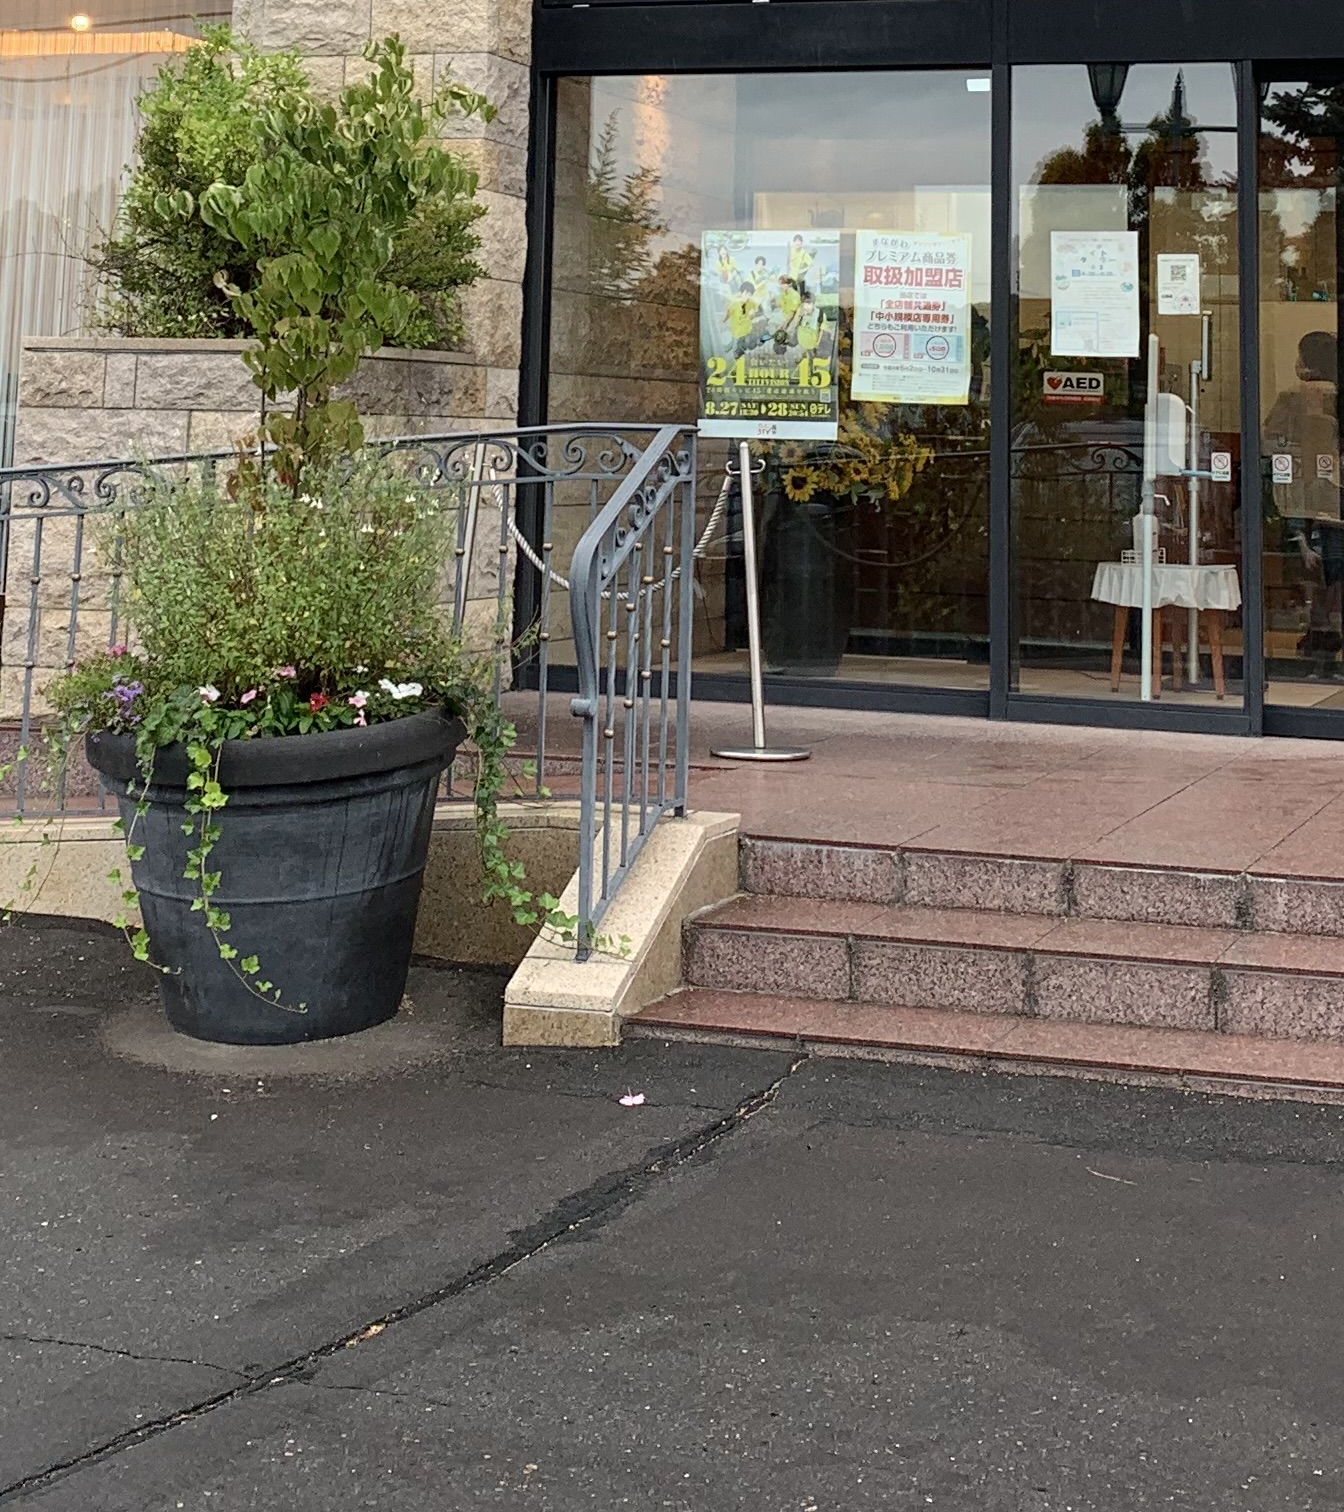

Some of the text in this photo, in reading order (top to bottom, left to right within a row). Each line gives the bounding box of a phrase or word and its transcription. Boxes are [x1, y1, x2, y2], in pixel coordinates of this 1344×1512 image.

[864, 250, 957, 265] プレミアム商品券
[863, 265, 963, 288] 取扱加盟店
[706, 355, 748, 387] 24
[790, 353, 832, 388] 45
[1062, 376, 1101, 390] AED
[705, 401, 739, 416] 8.27
[767, 402, 788, 417] 28
